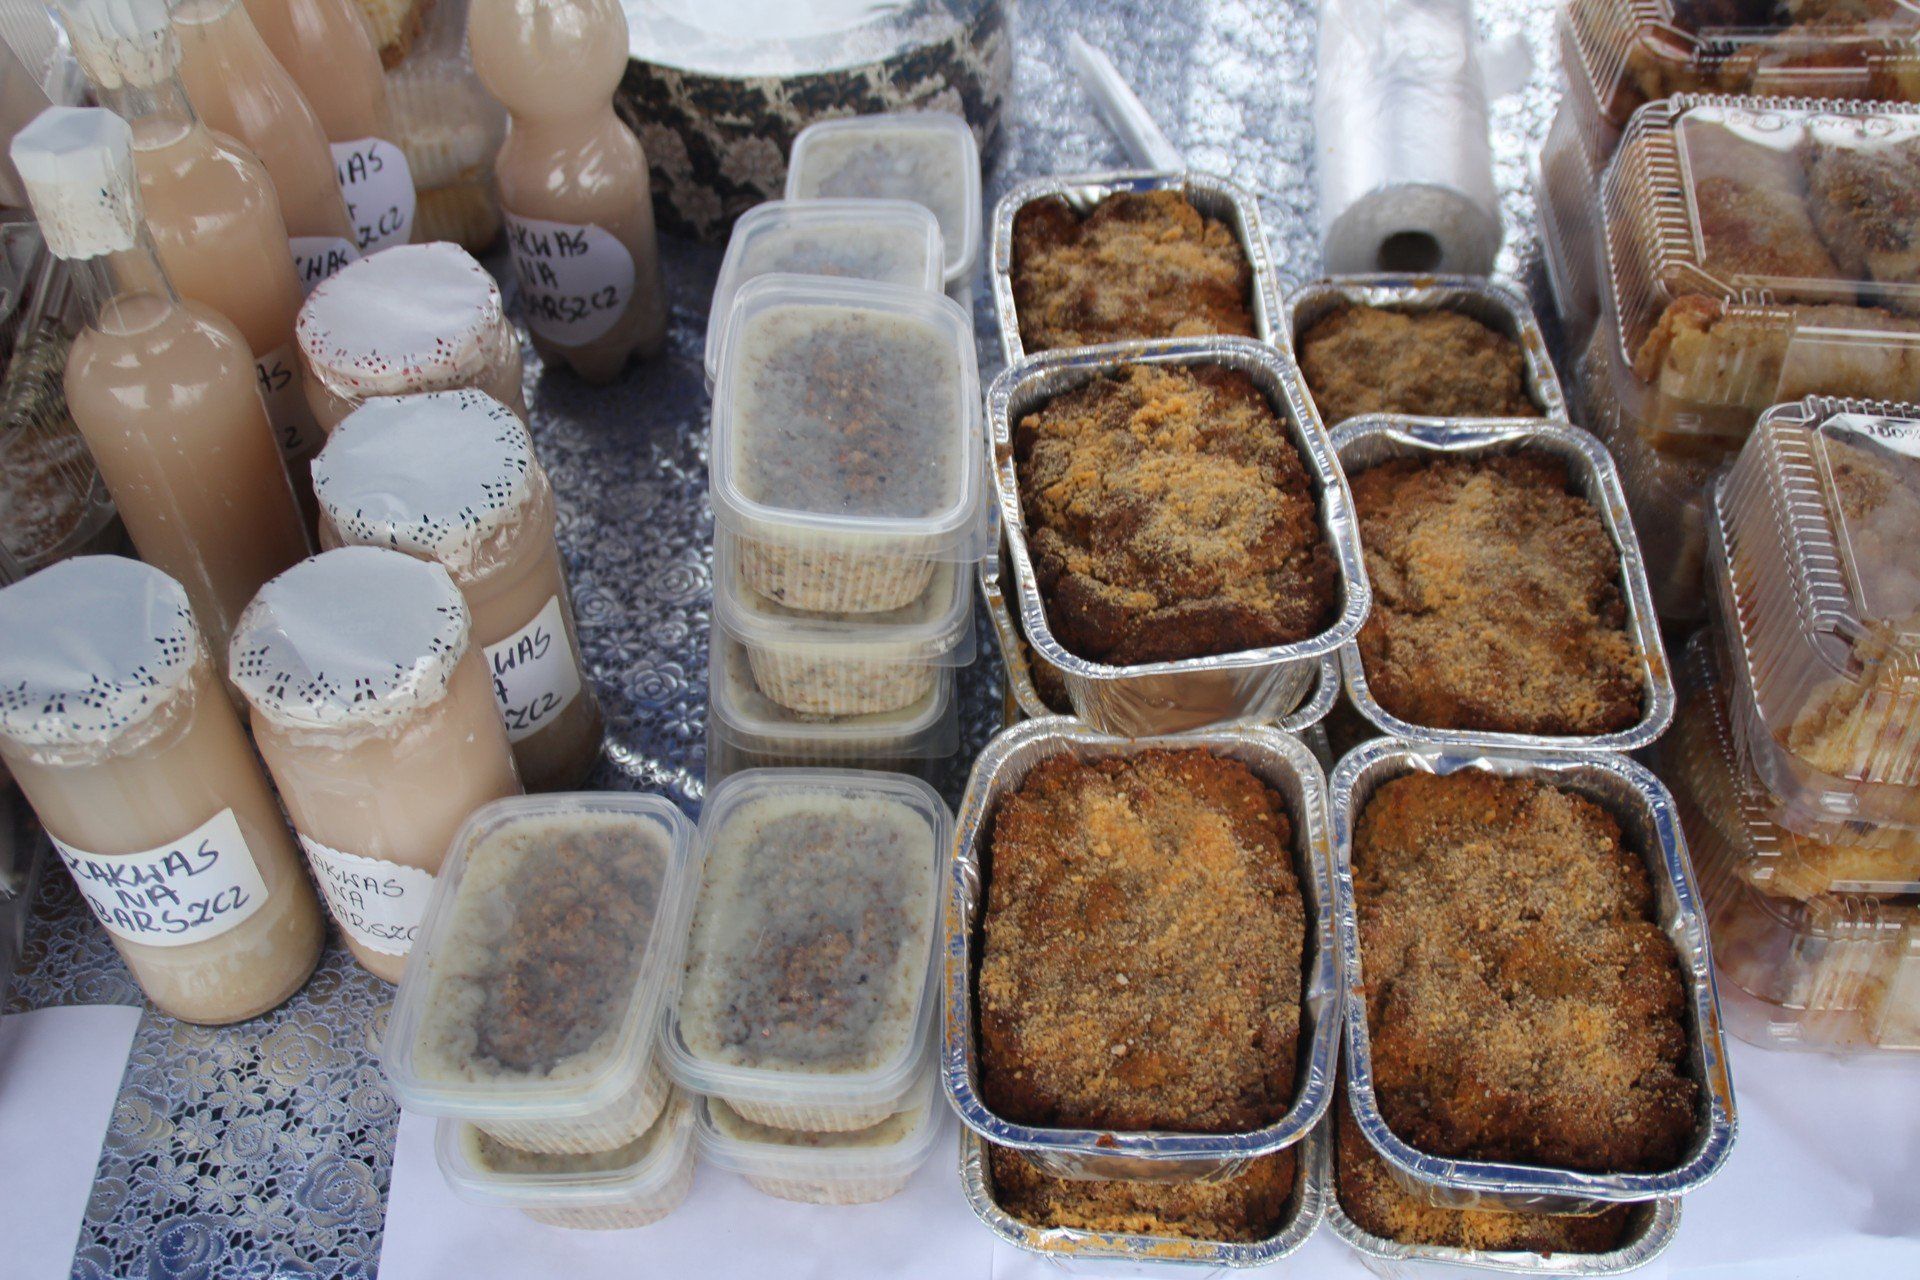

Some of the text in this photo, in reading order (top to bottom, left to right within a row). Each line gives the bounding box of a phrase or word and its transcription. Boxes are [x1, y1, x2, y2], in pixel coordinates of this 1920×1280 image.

[58, 838, 220, 887] ZAKWAS
[87, 885, 250, 934] BARSZCZ
[115, 883, 181, 909] NA
[330, 881, 365, 911] NA
